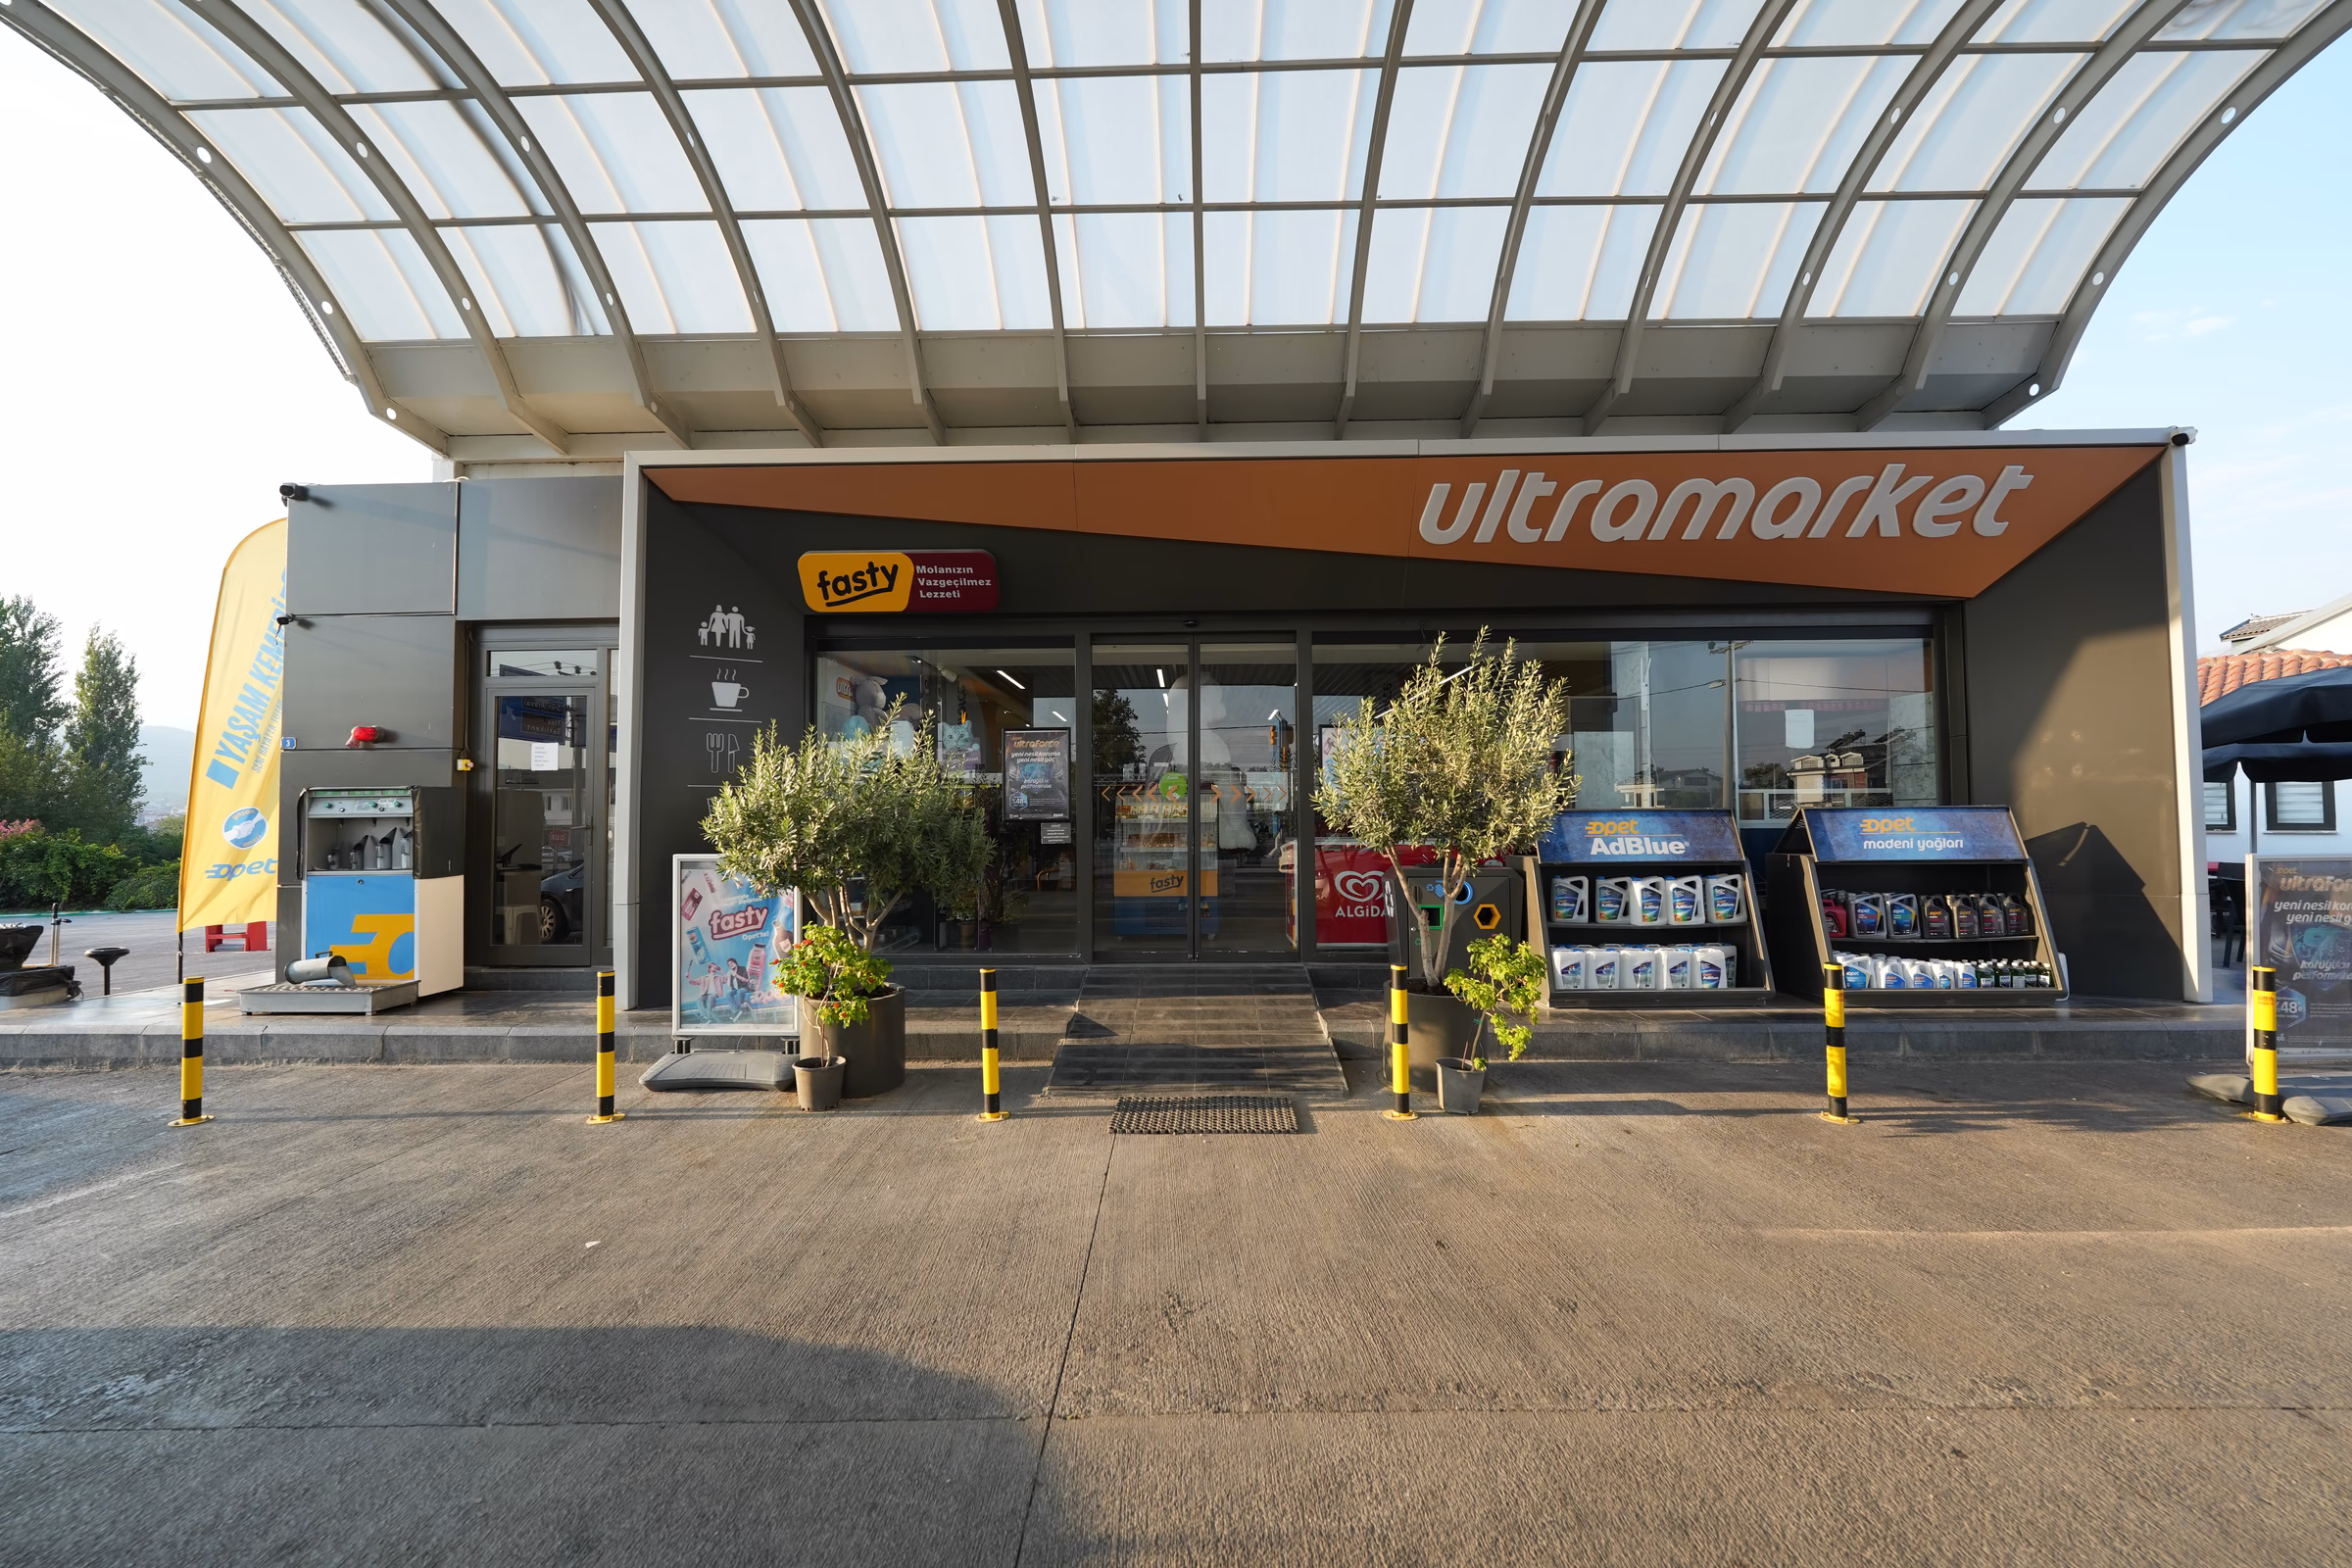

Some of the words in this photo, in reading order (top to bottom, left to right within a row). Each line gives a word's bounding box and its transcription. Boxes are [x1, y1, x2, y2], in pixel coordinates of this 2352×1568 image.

[1418, 463, 2034, 546] ultramarket
[916, 564, 974, 574] Molanızın
[817, 561, 899, 608] fasty
[917, 576, 992, 588] Vazgeçilmez
[919, 589, 961, 599] Lezzeti
[215, 682, 271, 764] YAŞAM
[1585, 819, 1640, 836] opet
[1859, 816, 1916, 834] opet
[1863, 838, 1914, 850] madeni
[1916, 838, 1964, 852] yağları
[204, 858, 279, 882] opet
[1150, 874, 1184, 894] fasty
[2274, 900, 2302, 912] yeni
[2302, 900, 2331, 911] nesil
[709, 905, 768, 940] fasty
[2285, 911, 2314, 925] yeni
[2314, 911, 2343, 923] nesil
